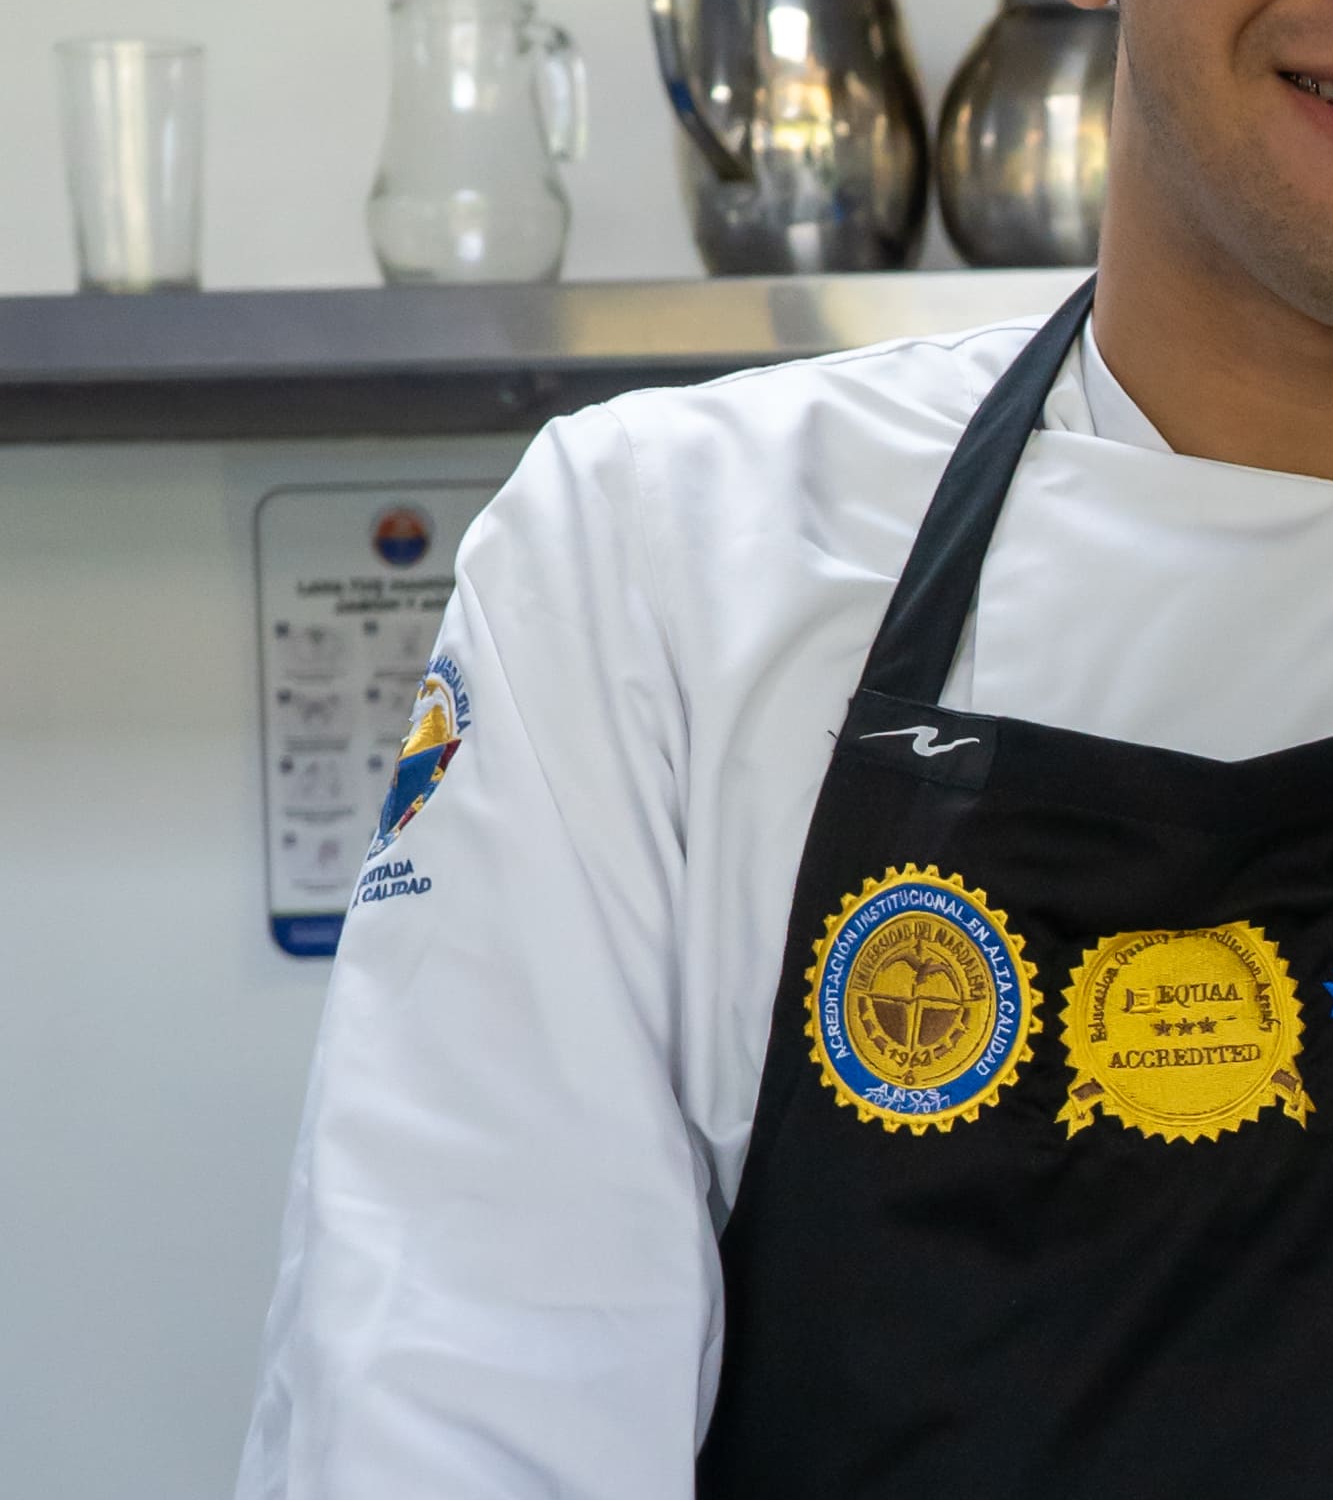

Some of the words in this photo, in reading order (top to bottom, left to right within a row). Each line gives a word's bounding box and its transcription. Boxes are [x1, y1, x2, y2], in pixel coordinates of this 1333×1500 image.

[854, 888, 964, 933] INSTITUCIONAL
[968, 917, 990, 944] EN
[988, 943, 1014, 997] ALTA
[825, 928, 859, 1060] ACREDITACIÓN
[1157, 983, 1243, 1008] EQUAA
[974, 998, 1016, 1077] CALIDAD
[1108, 1044, 1261, 1069] ACCREDITED
